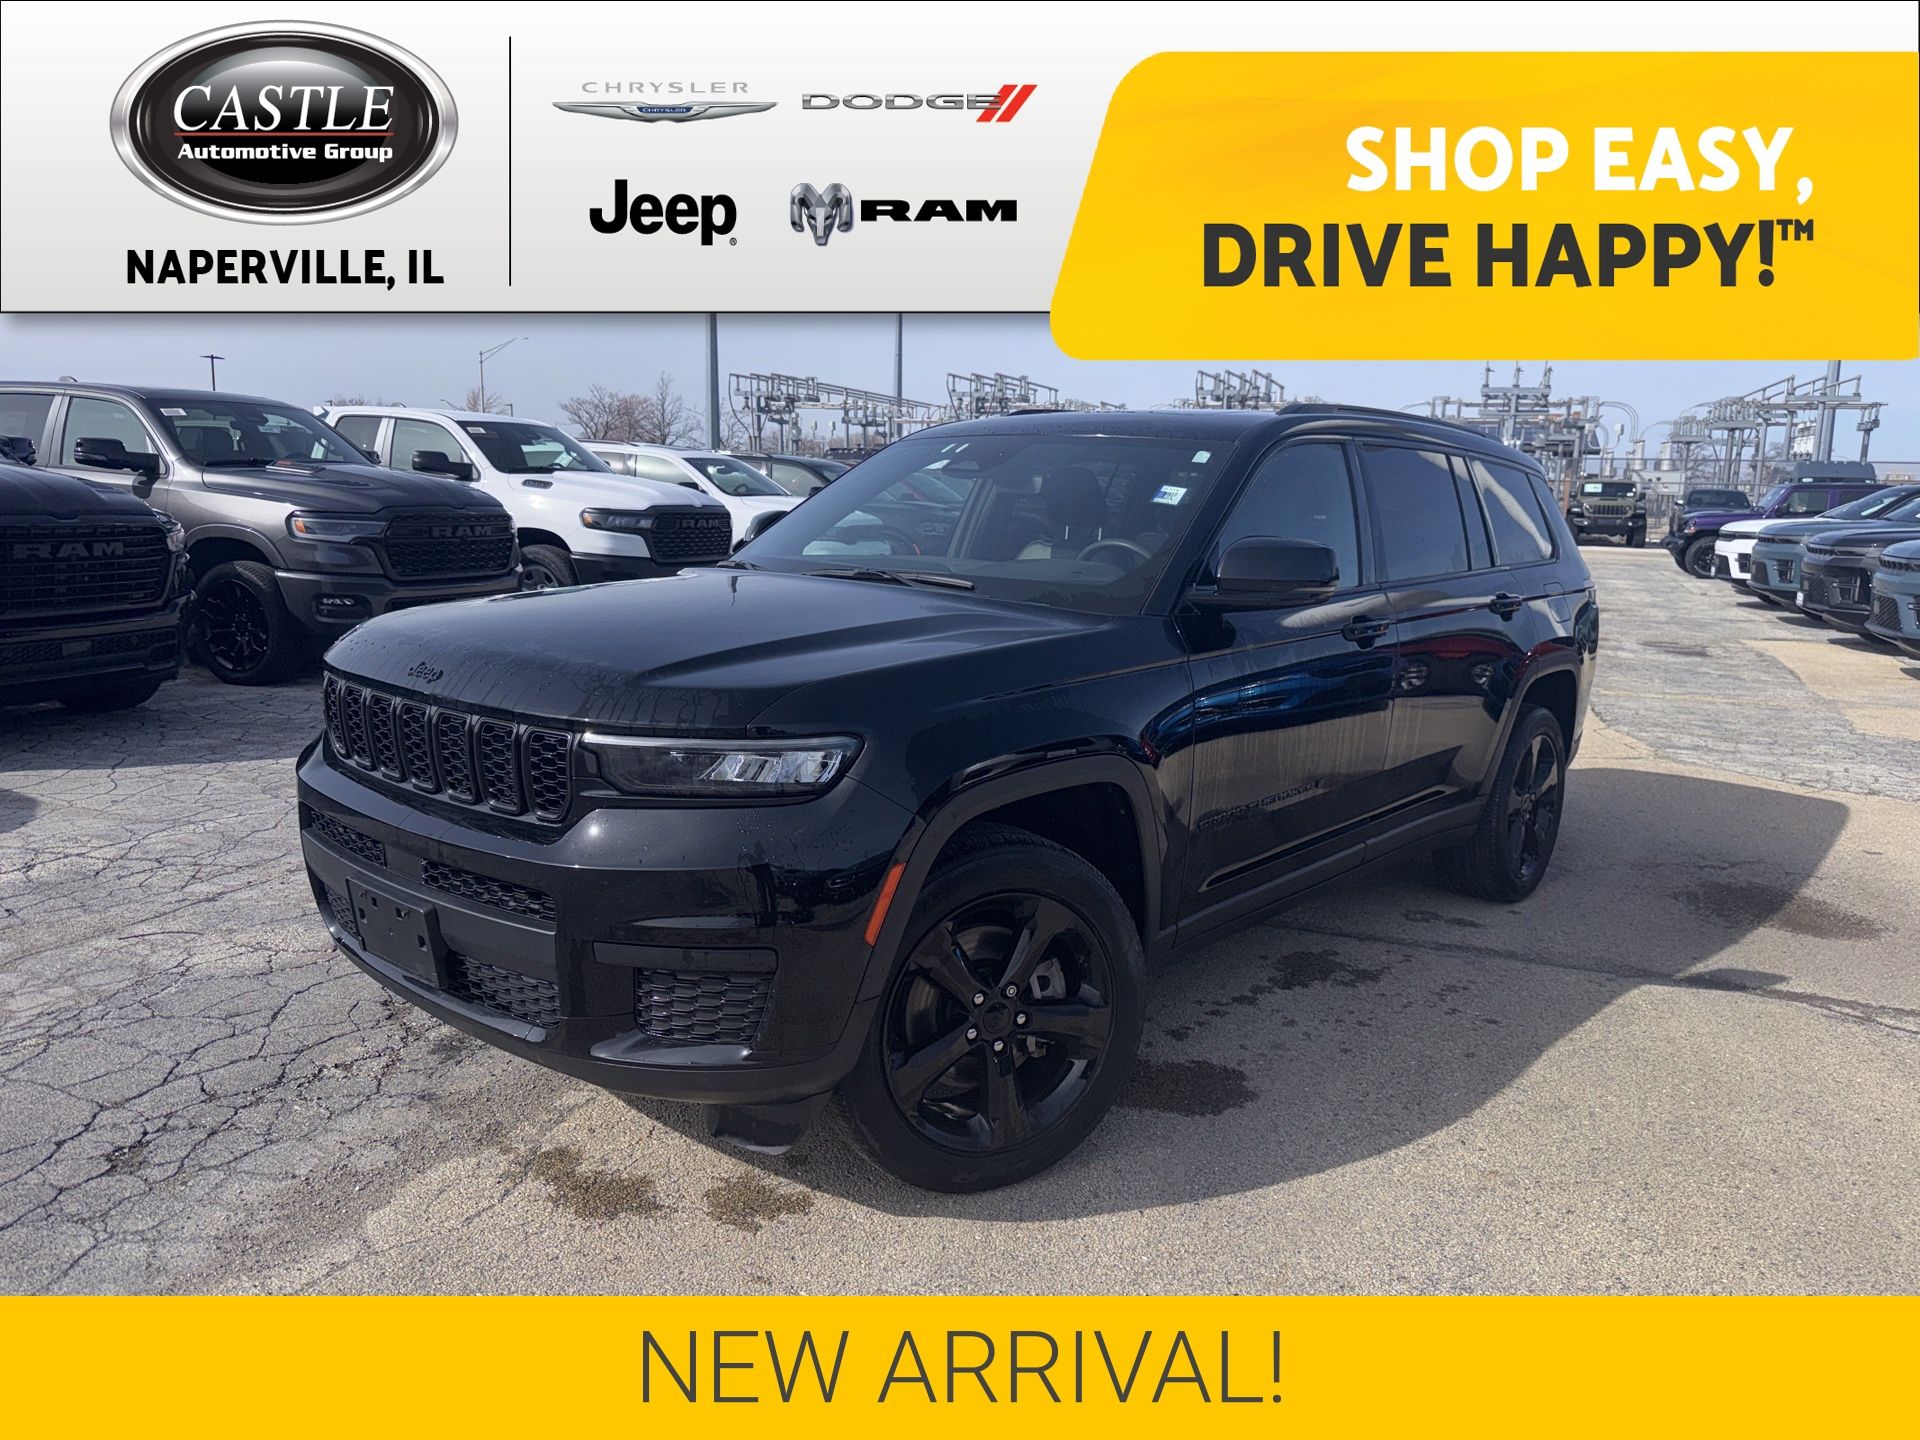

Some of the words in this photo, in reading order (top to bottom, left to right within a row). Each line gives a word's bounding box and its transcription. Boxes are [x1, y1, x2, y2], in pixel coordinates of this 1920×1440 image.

[681, 519, 719, 528] RAM
[432, 526, 492, 537] RAM
[13, 541, 124, 558] RAM
[408, 661, 444, 684] Jeep
